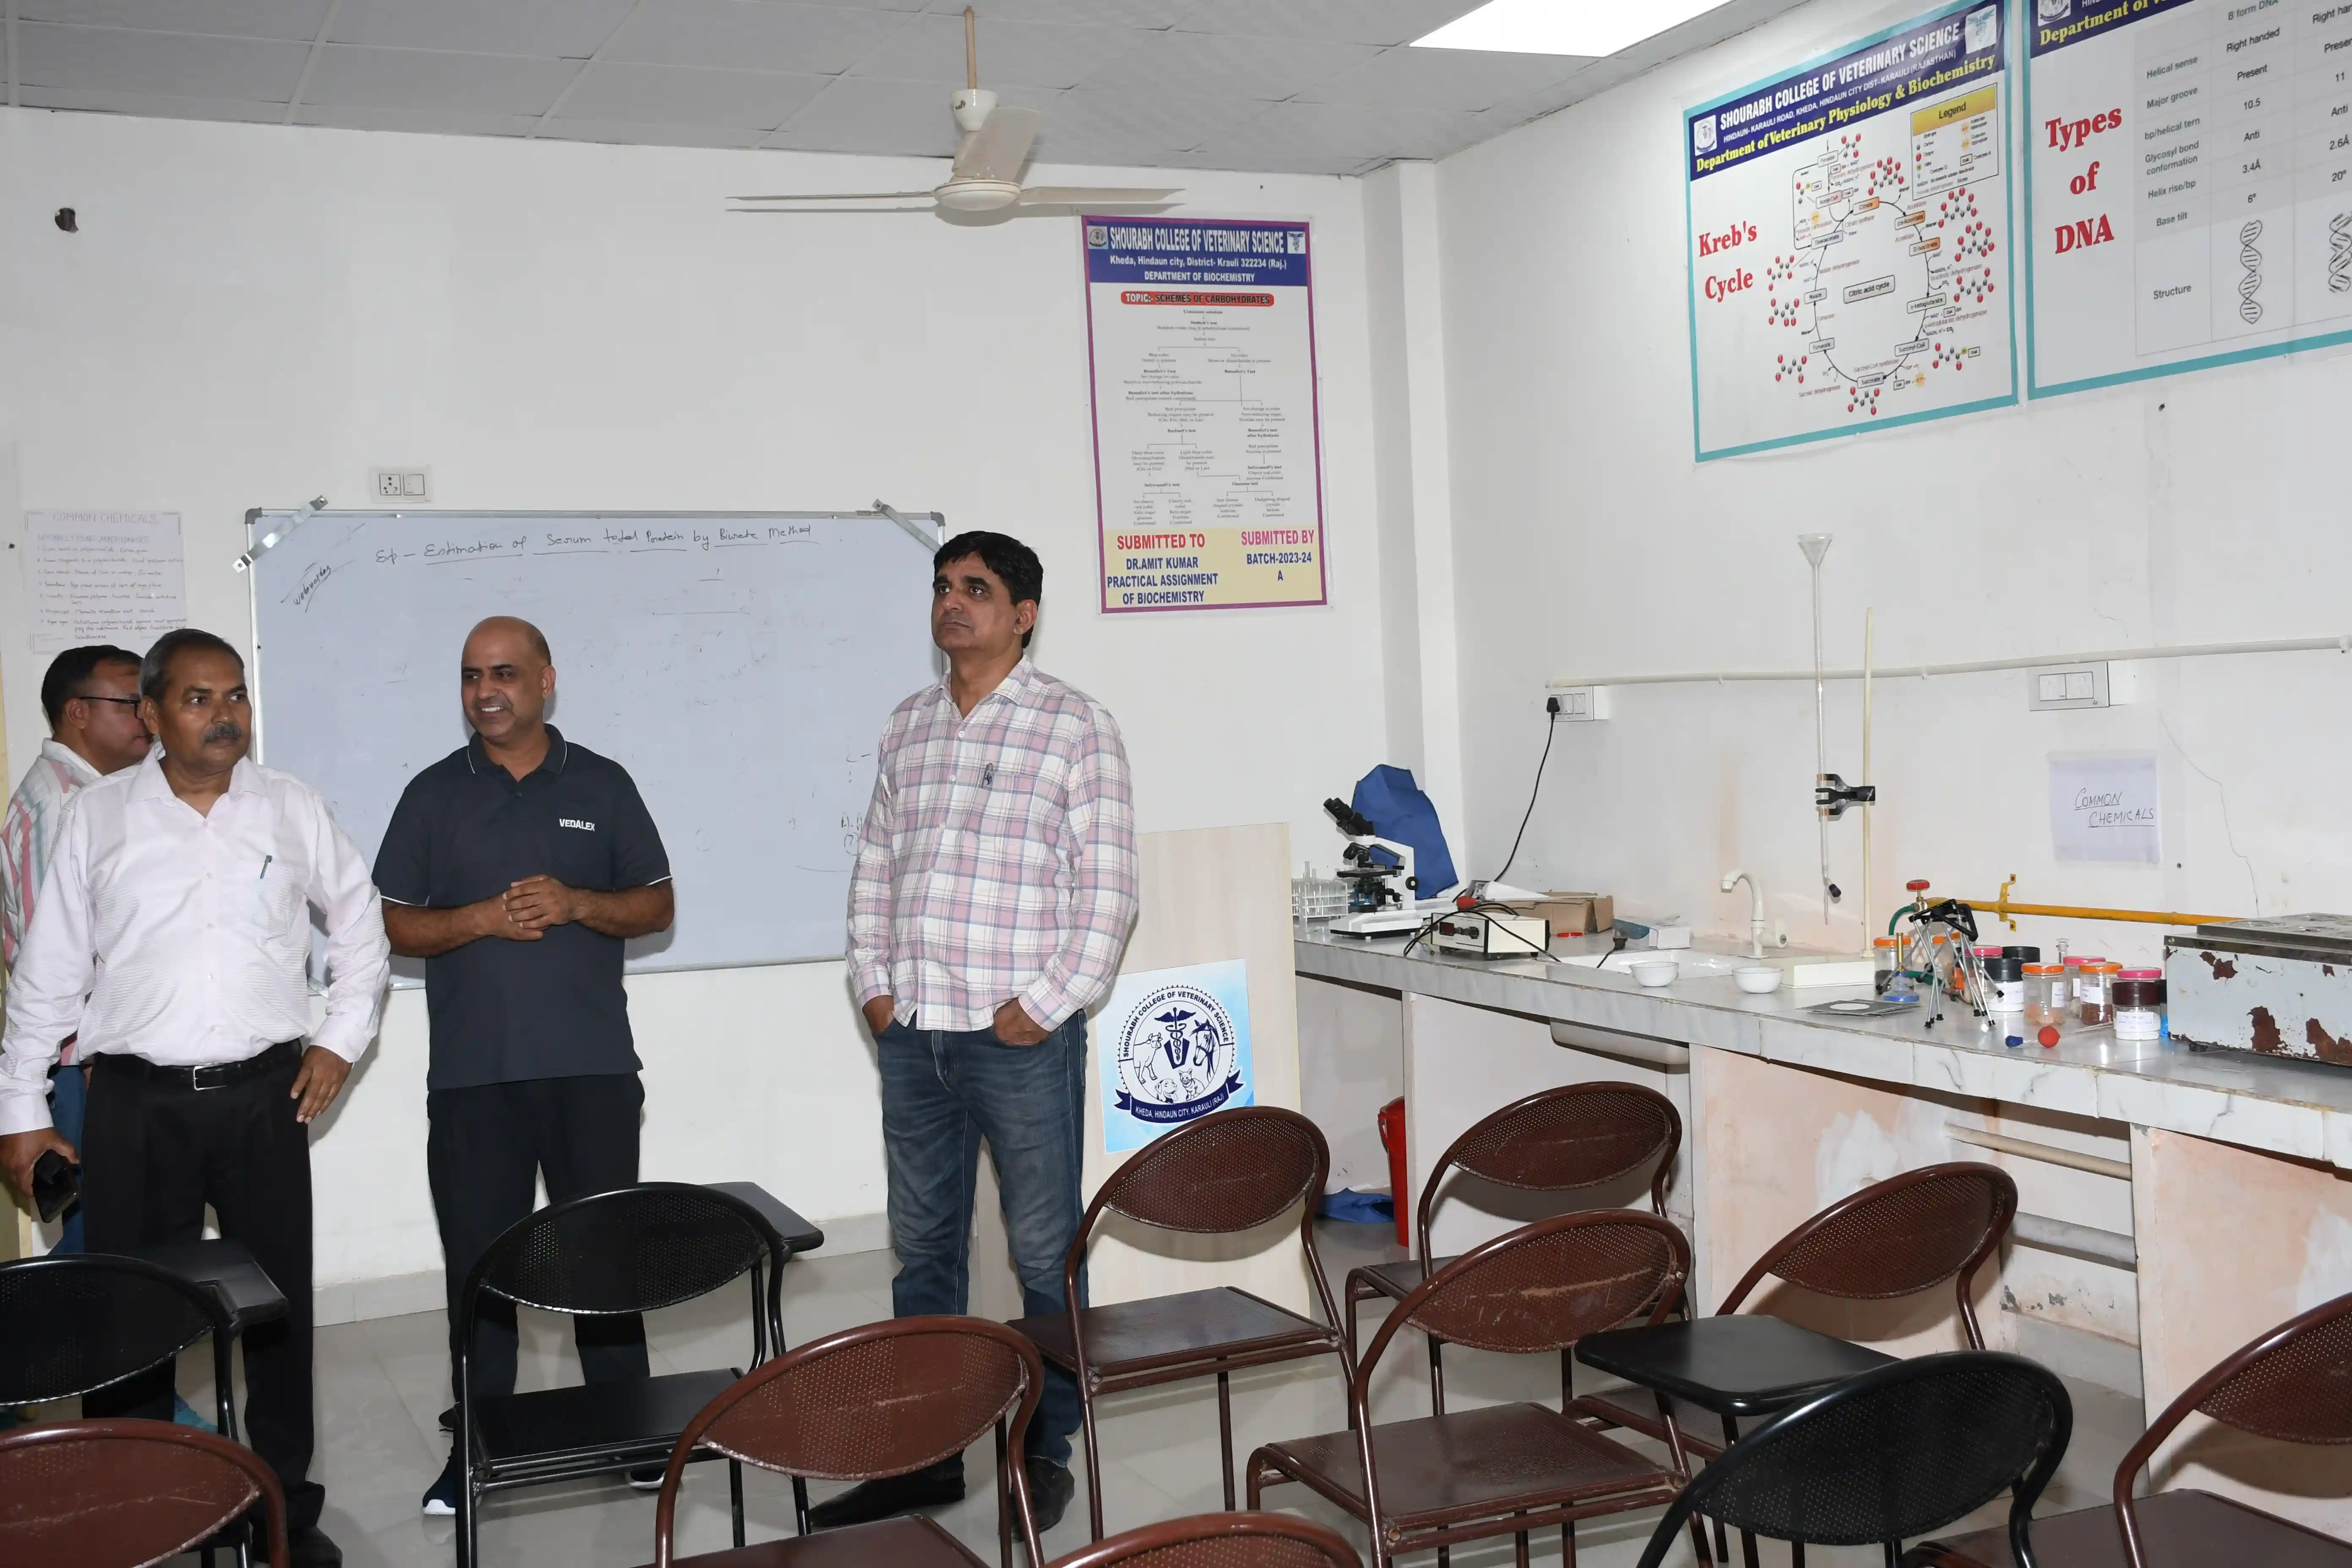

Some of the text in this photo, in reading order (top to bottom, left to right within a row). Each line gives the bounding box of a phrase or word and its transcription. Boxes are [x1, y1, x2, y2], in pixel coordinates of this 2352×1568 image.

[2228, 11, 2234, 20] B
[2237, 5, 2256, 17] form
[2313, 9, 2335, 24] Right
[2040, 1, 2129, 45] Department
[2227, 27, 2280, 52] Right handed
[1720, 22, 1960, 130] SHOURABH COLLEGE OF VETERINARY SCIENCE
[2147, 57, 2198, 79] Helical sense
[2238, 65, 2268, 81] Present
[2336, 72, 2344, 82] 11
[1777, 111, 1795, 123] ROAD,
[1796, 103, 1818, 116] KHEDA,
[1819, 90, 1847, 107] HINDAUN
[1848, 85, 1862, 96] CITY
[1911, 49, 1957, 75] (RAJASTHAN)
[2147, 87, 2198, 109] Major groove
[2244, 98, 2260, 110] 10.5
[1696, 54, 1995, 172] Department of Veterinary Physiology & Biochemistry
[1938, 102, 1966, 120] Legend
[2331, 104, 2348, 117] Anti
[2046, 108, 2122, 152] Types
[2145, 121, 2181, 140] bp/helical
[2244, 130, 2260, 142] Anti
[2145, 140, 2199, 163] Glycosyl bond
[2146, 155, 2198, 175] conformation
[2070, 161, 2100, 195] of
[2148, 180, 2196, 199] Helix rise/bp
[2156, 212, 2188, 227] Base tilt
[1110, 227, 1284, 253] SHOURABH COLLEGE OF VETERINARY SCIENCE
[1698, 221, 1757, 258] Kreb's
[2055, 213, 2114, 254] DNA
[1110, 255, 1136, 267] Kheda,
[1138, 256, 1168, 266] Hindaun
[1170, 257, 1185, 268] city,
[1217, 258, 1239, 267] Krauli
[1241, 259, 1266, 268] 322234
[1268, 259, 1287, 270] (Raj.)
[1144, 271, 1255, 282] DEPARTMENT OF BIOCHEMISTRY
[1705, 269, 1753, 303] Cycle
[1848, 282, 1889, 297] Citric acid cycle
[2153, 284, 2191, 299] Structure
[1155, 294, 1192, 303] SCHEMES
[1194, 295, 1203, 303] OF
[1206, 295, 1270, 304] CARBOHYDRATES
[424, 541, 503, 557] Estimation
[693, 530, 710, 551] by
[1117, 534, 1205, 550] SUBMITTED TO
[1241, 530, 1315, 545] SUBMITTED BY
[1126, 557, 1198, 570] DR.AMIT KUMAR
[1247, 551, 1312, 564] BATCH-2023-24
[1107, 573, 1218, 588] PRACTICAL ASSIGNMENT
[1277, 570, 1283, 581] A
[1122, 591, 1204, 604] OF BIOCHEMISTRY
[2075, 788, 2123, 809] COMMON
[559, 818, 595, 831] VEDALEX
[2089, 808, 2154, 828] CHEMICALS
[1124, 1016, 1140, 1058] SHOURABH
[1138, 994, 1166, 1016] COLLEGE
[1178, 991, 1216, 1012] VETERINARY
[1214, 1012, 1229, 1043] SCIENCE
[1135, 1092, 1225, 1119] KHEDA, HINDAUN CITY, KARAULI (RAJ)
